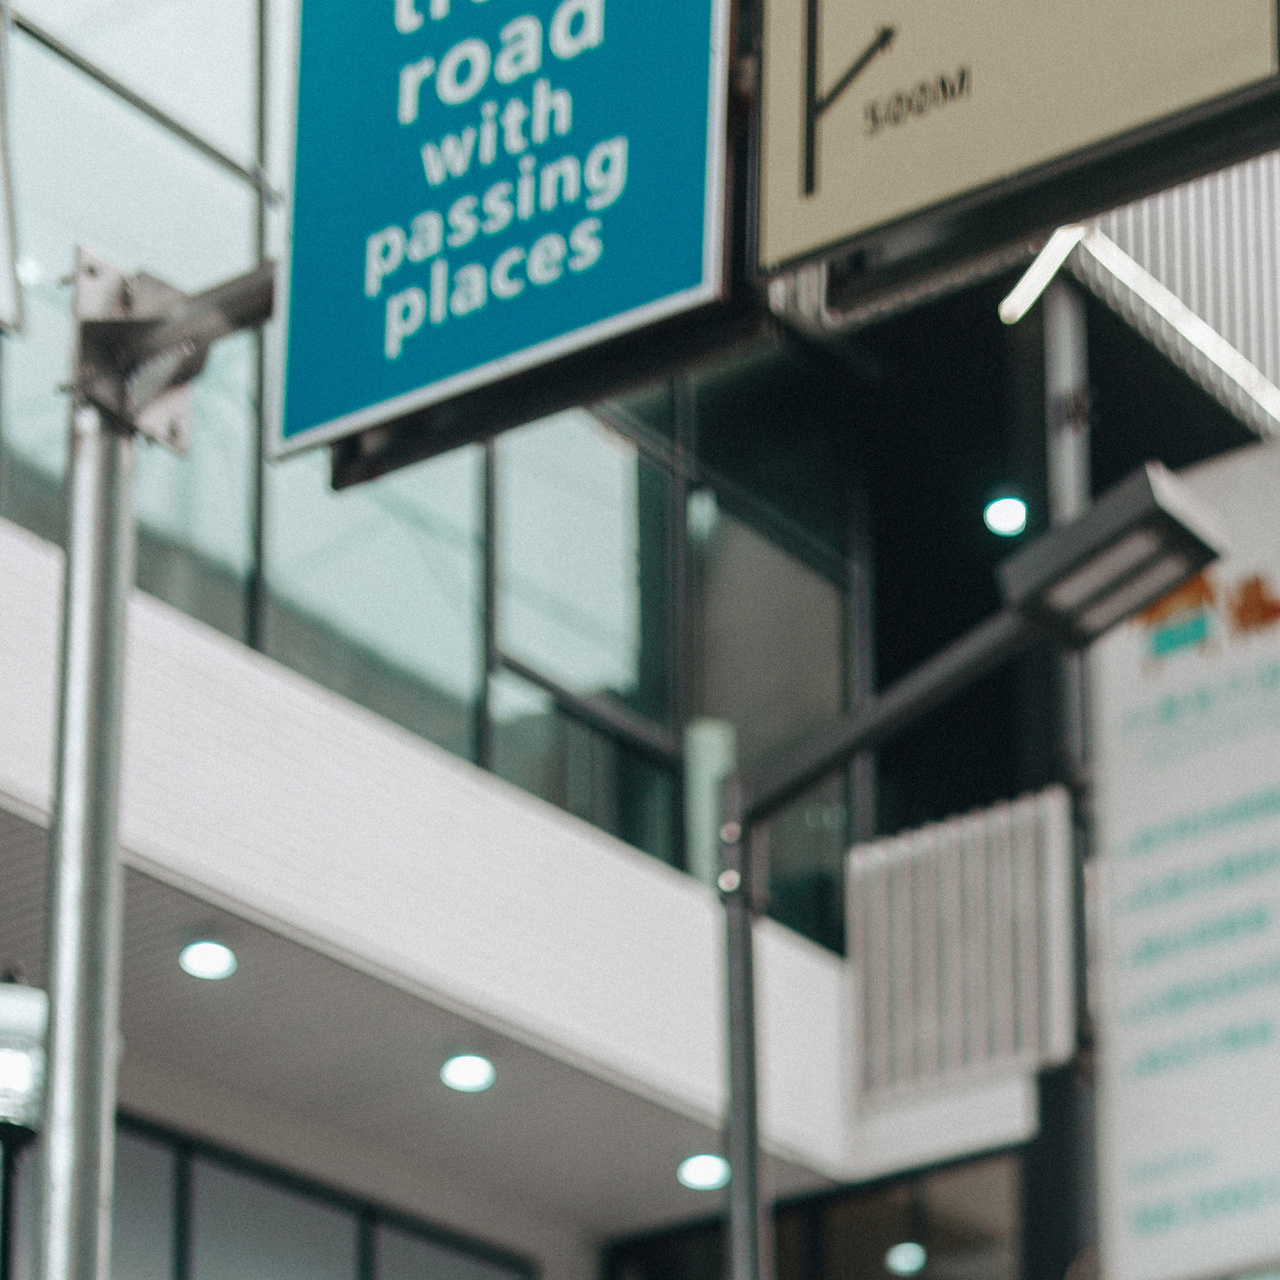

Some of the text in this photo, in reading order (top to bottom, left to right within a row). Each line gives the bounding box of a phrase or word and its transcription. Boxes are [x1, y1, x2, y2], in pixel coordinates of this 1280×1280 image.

[397, 0, 606, 126] road
[862, 66, 972, 137] 500M
[420, 77, 574, 184] with
[364, 135, 630, 298] passing
[384, 216, 604, 360] places
